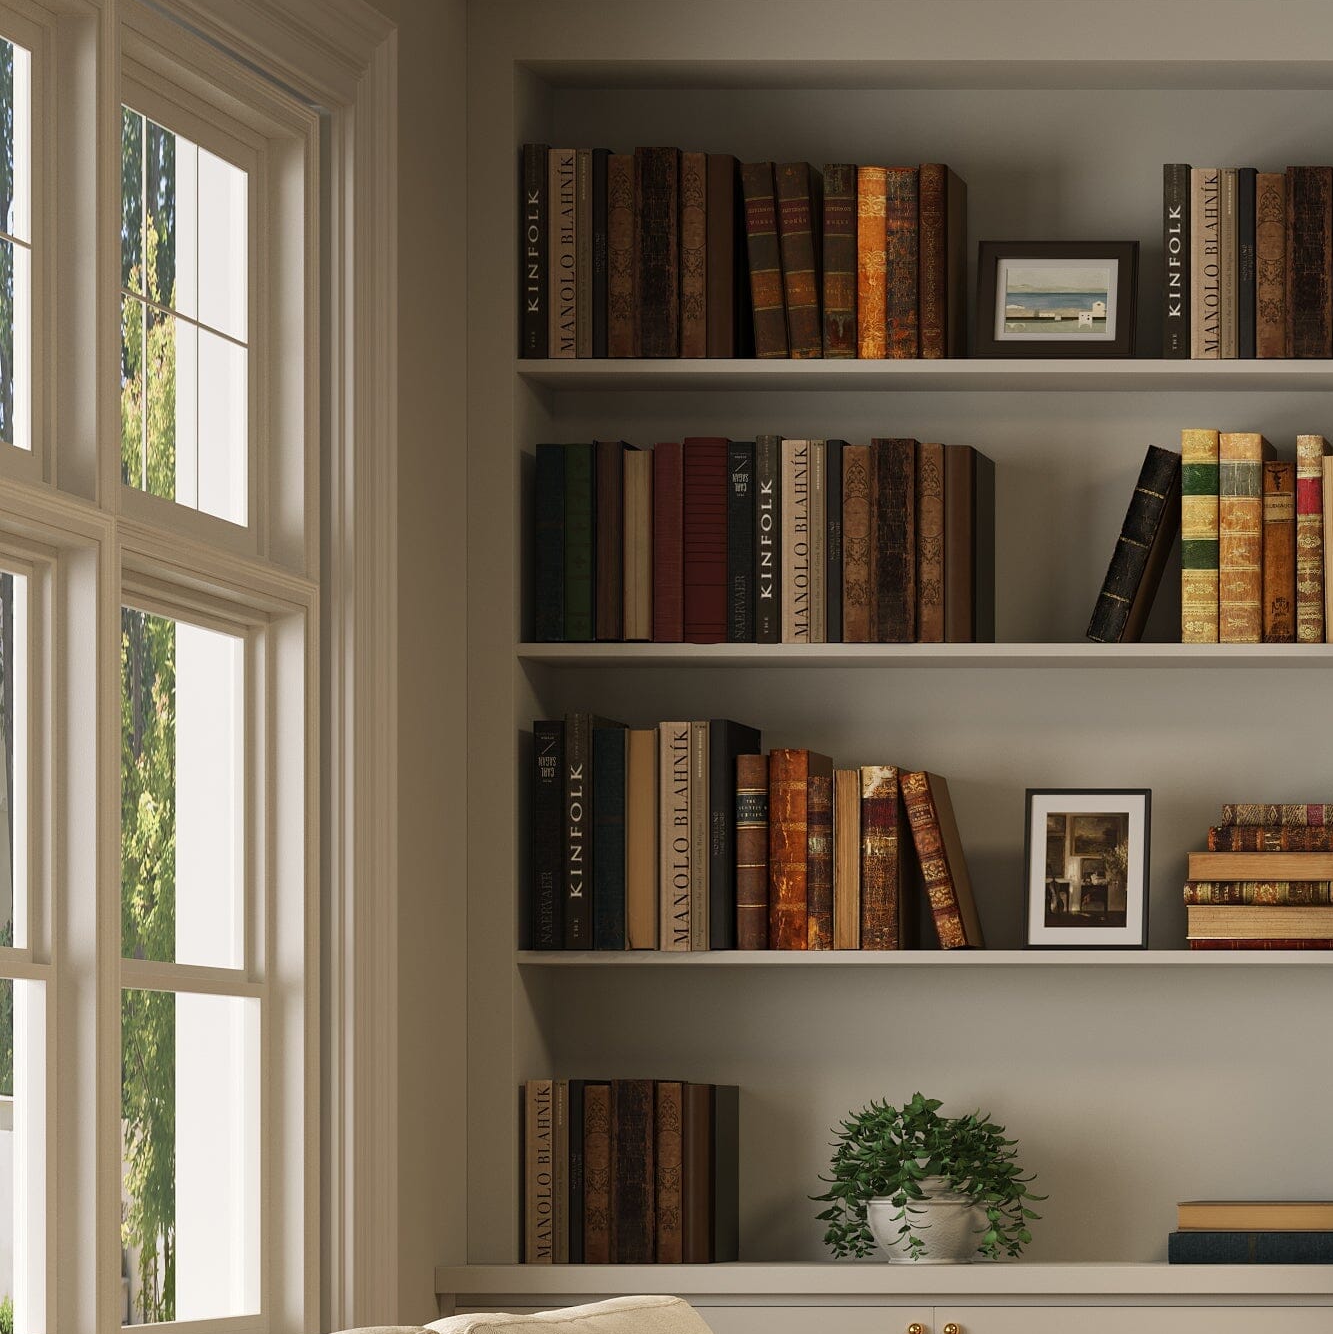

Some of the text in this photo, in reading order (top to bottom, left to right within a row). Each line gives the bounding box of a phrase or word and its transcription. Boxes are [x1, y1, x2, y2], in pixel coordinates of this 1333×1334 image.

[528, 189, 539, 312] KINFOLK
[557, 157, 575, 352] MANOLO BLAHNÍK
[1169, 205, 1180, 317] KINFOLK
[1201, 176, 1219, 352] MANOLO BLAHNÍK
[761, 479, 772, 598] KINFOLK
[790, 447, 808, 636] MANOLO BLAHNÍK
[570, 763, 583, 898] KINFOLK
[670, 731, 690, 944] MANOLO BLAHNÍK
[534, 1086, 551, 1257] MANOLO BLAHNÍK
